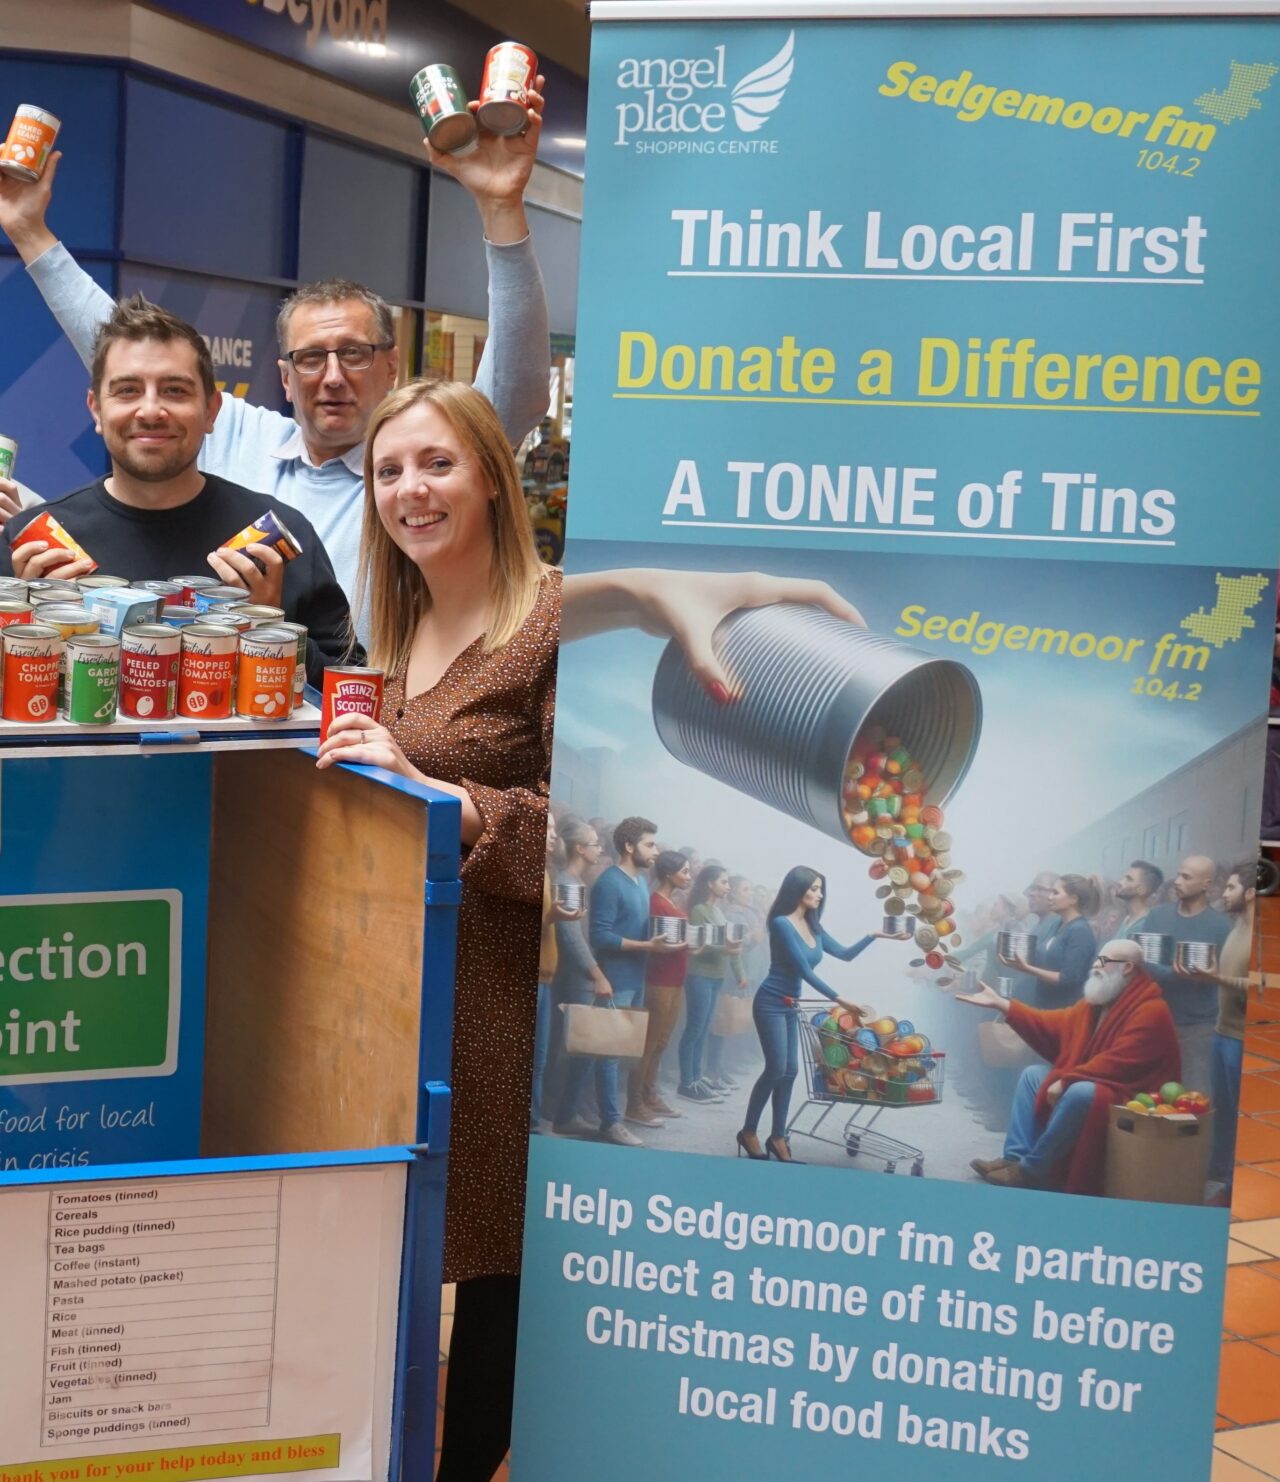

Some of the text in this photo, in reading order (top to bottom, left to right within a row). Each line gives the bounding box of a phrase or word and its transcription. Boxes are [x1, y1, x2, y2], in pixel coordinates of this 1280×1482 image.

[617, 44, 727, 101] angel
[878, 60, 1218, 151] Sedgemoor fm
[614, 89, 725, 145] place
[635, 140, 779, 154] SHOPPING CENTRE
[1134, 149, 1202, 178] 104.2
[671, 209, 1207, 275] Think Local First
[617, 331, 1261, 406] Donate a Difference
[662, 460, 1176, 537] A TONNE of Tins
[895, 604, 1210, 675] Sedgemoor fm
[126, 658, 160, 670] PEELED
[184, 659, 231, 670] CHOPPED
[256, 665, 288, 675] BAKED
[129, 668, 154, 678] PLUM
[256, 674, 287, 684] BEANS
[340, 682, 374, 697] HEINZ
[1130, 676, 1203, 701] 104.2
[336, 700, 373, 713] SCOTCH
[55, 1106, 89, 1132] for
[100, 1102, 156, 1128] local
[28, 1148, 89, 1169] crisis
[57, 1190, 158, 1205] Tomatoes (tinned)
[55, 1210, 98, 1222] Cereals
[55, 1220, 175, 1238] Rice pudding (tinned)
[545, 1181, 1204, 1294] Help Sedgemoor fm & partners
[55, 1243, 105, 1255] Tea bags
[54, 1256, 141, 1272] Coffee (instant)
[53, 1271, 184, 1289] Mashed potato (packet)
[53, 1296, 84, 1306] Pasta
[562, 1250, 1175, 1354] collect a tonne of tins before
[52, 1312, 77, 1322] Rice
[51, 1342, 121, 1356] Fish (tinned)
[50, 1362, 76, 1372] Fruit
[586, 1306, 1142, 1412] Christmas by donating for
[114, 1371, 157, 1385] (tinned)
[49, 1395, 72, 1405] Jam
[97, 1404, 144, 1417] or snack
[678, 1377, 1030, 1460] local food banks
[47, 1421, 145, 1440] Sponge puddings
[86, 1442, 326, 1480] for your help today and bless
